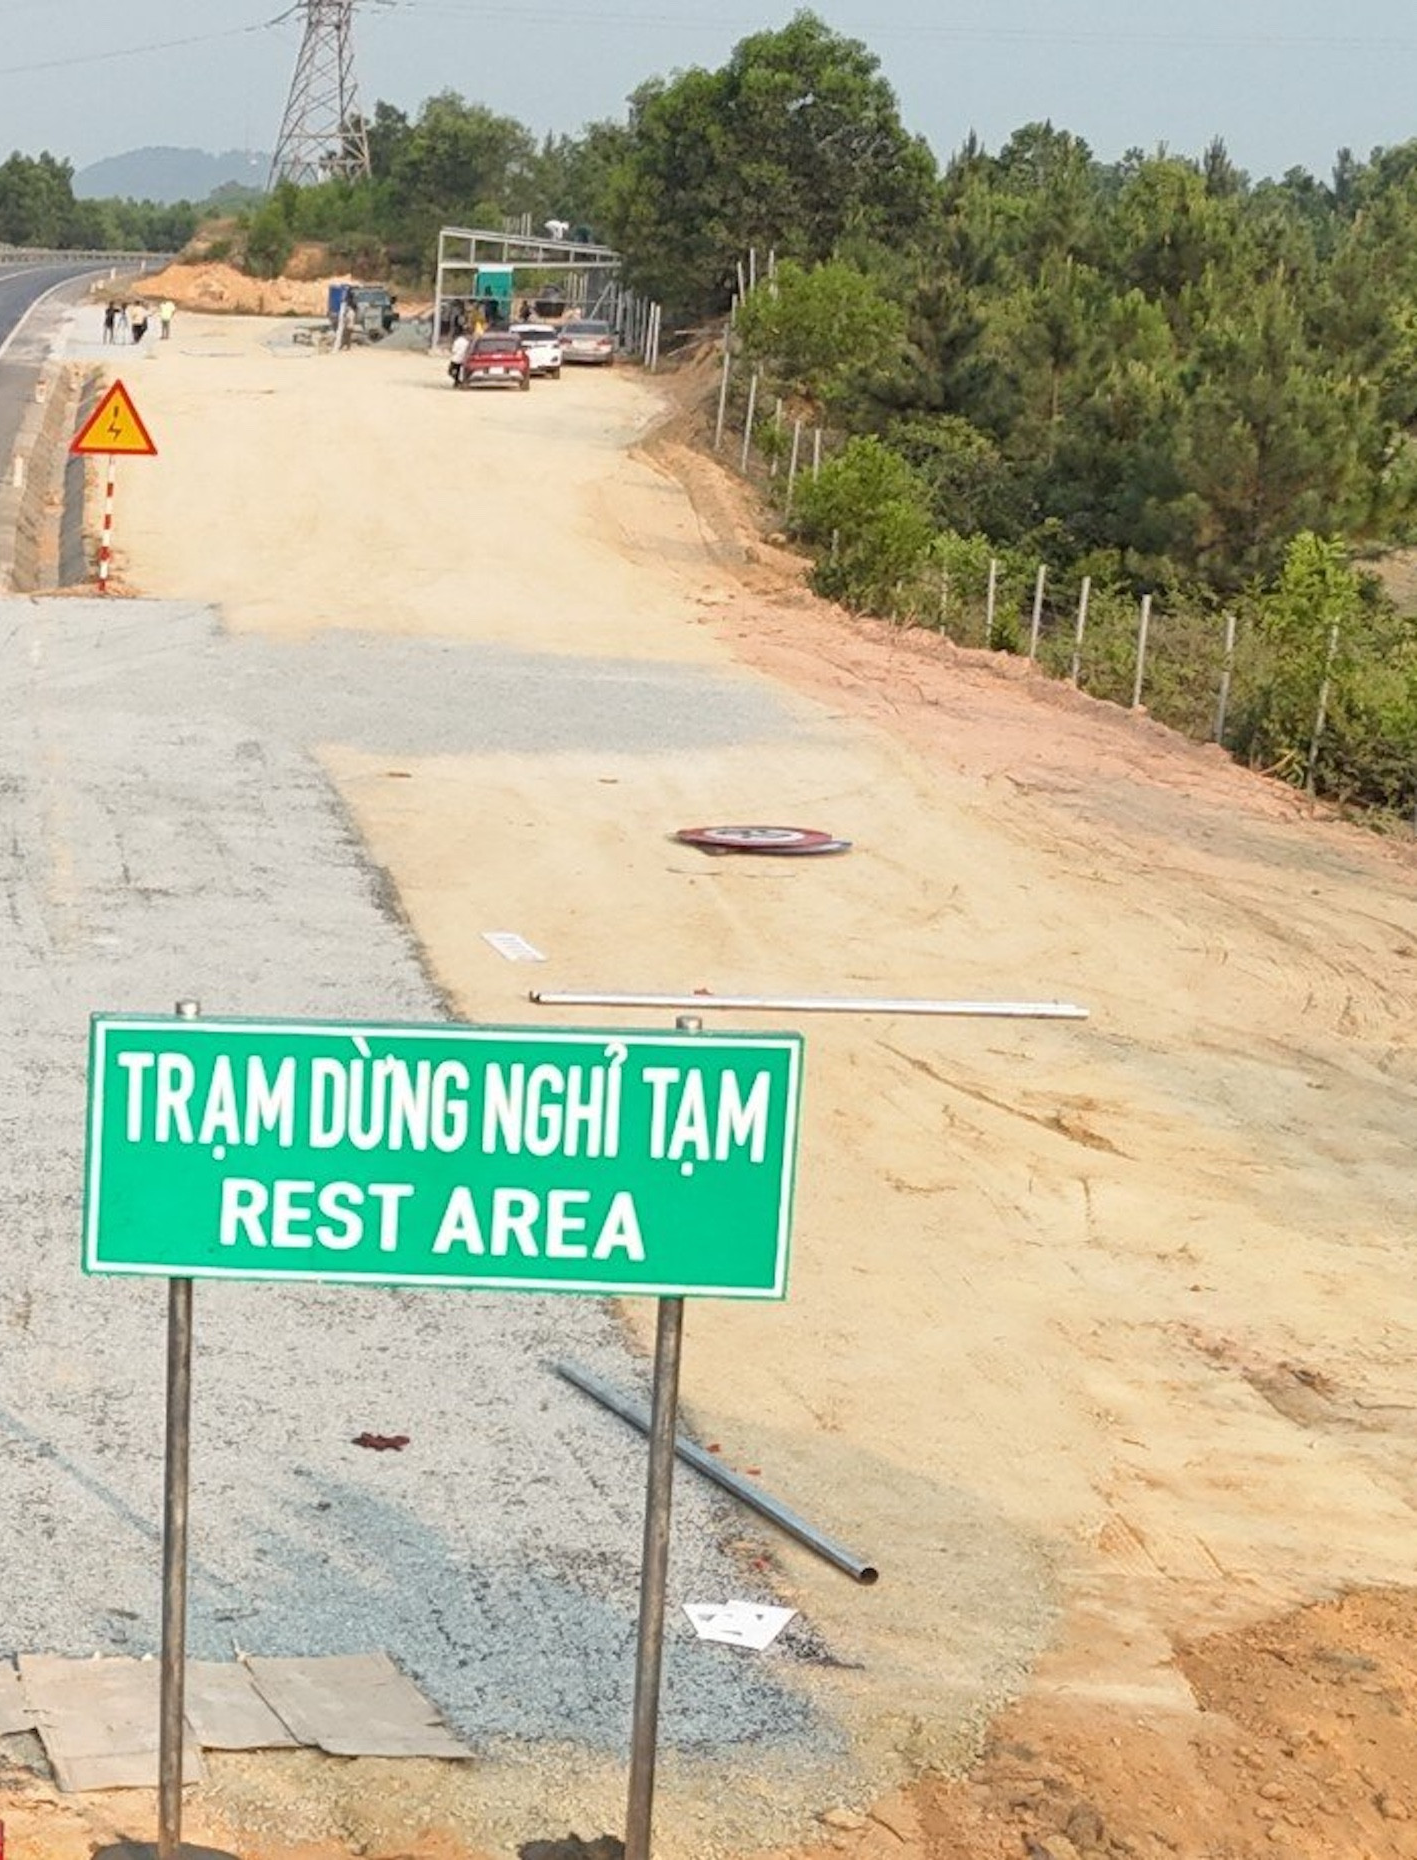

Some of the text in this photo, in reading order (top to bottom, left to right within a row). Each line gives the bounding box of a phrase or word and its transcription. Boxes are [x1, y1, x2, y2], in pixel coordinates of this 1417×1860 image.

[117, 1035, 771, 1176] TRẠM DỪNG NGHỈ TẠM
[219, 1178, 646, 1261] REST AREA
